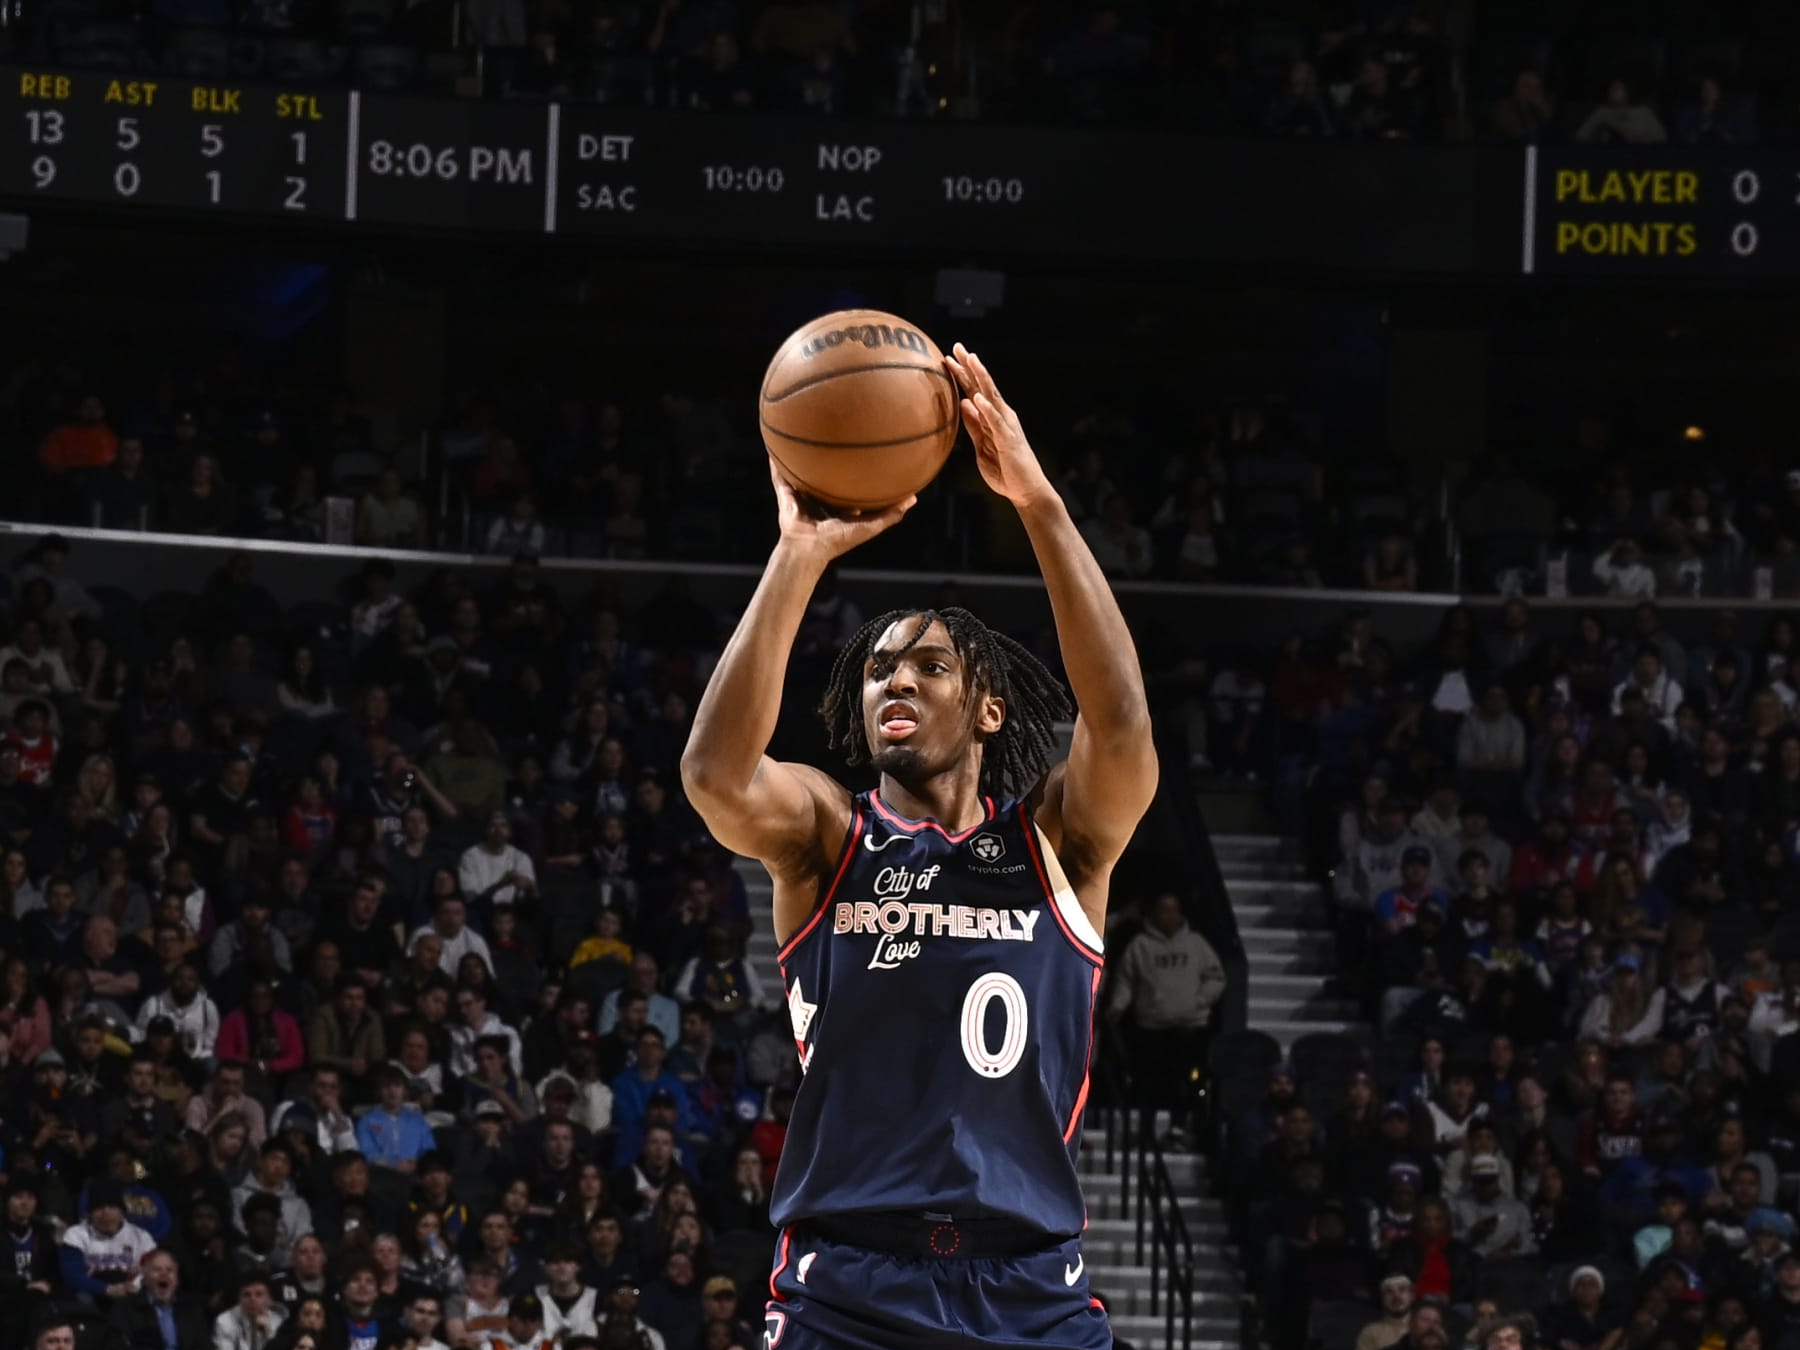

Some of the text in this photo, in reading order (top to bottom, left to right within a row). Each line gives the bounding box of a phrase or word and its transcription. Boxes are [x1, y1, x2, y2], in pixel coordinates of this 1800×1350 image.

[20, 72, 322, 120] REB AST BLK STL
[25, 109, 307, 164] 13 5 5 1
[578, 133, 634, 161] DET
[369, 140, 533, 184] 8:06 PM
[818, 145, 882, 172] NOP
[31, 155, 307, 210] 9 0 1 2
[703, 166, 785, 192] 10:00
[943, 176, 1024, 202] 10:00
[1556, 169, 1698, 203] PLAYER
[1732, 169, 1761, 204] 0
[577, 184, 636, 211] SAC
[816, 194, 874, 222] LAC
[1556, 221, 1759, 256] POINTS 0
[873, 865, 940, 904] City of
[834, 902, 1040, 941] BROTHERLY
[868, 934, 920, 970] Love
[960, 971, 1029, 1079] 0
